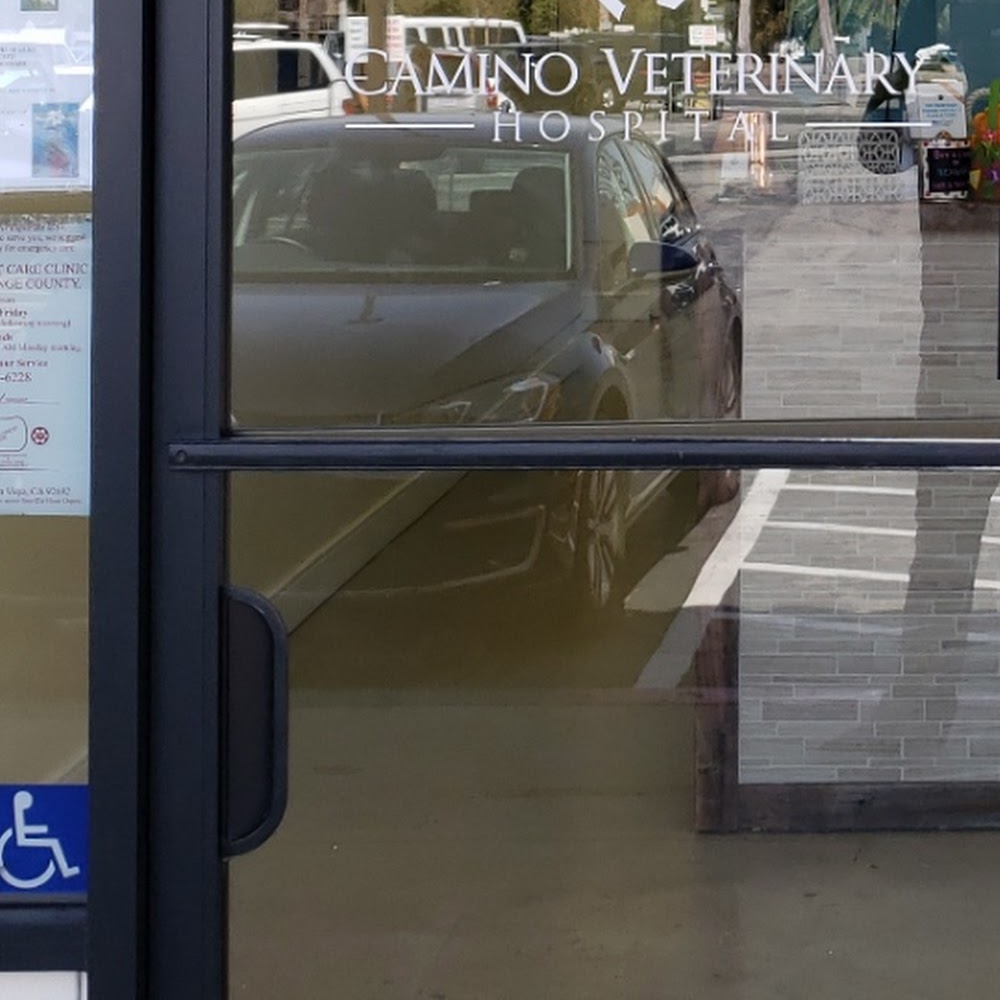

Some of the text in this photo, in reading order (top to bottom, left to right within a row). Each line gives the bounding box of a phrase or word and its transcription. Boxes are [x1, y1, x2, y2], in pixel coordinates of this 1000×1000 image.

[345, 47, 923, 96] CAMINO VETERINARY
[492, 110, 790, 143] HOSPITAL
[6, 262, 41, 275] CARE
[44, 262, 88, 275] CLINIC
